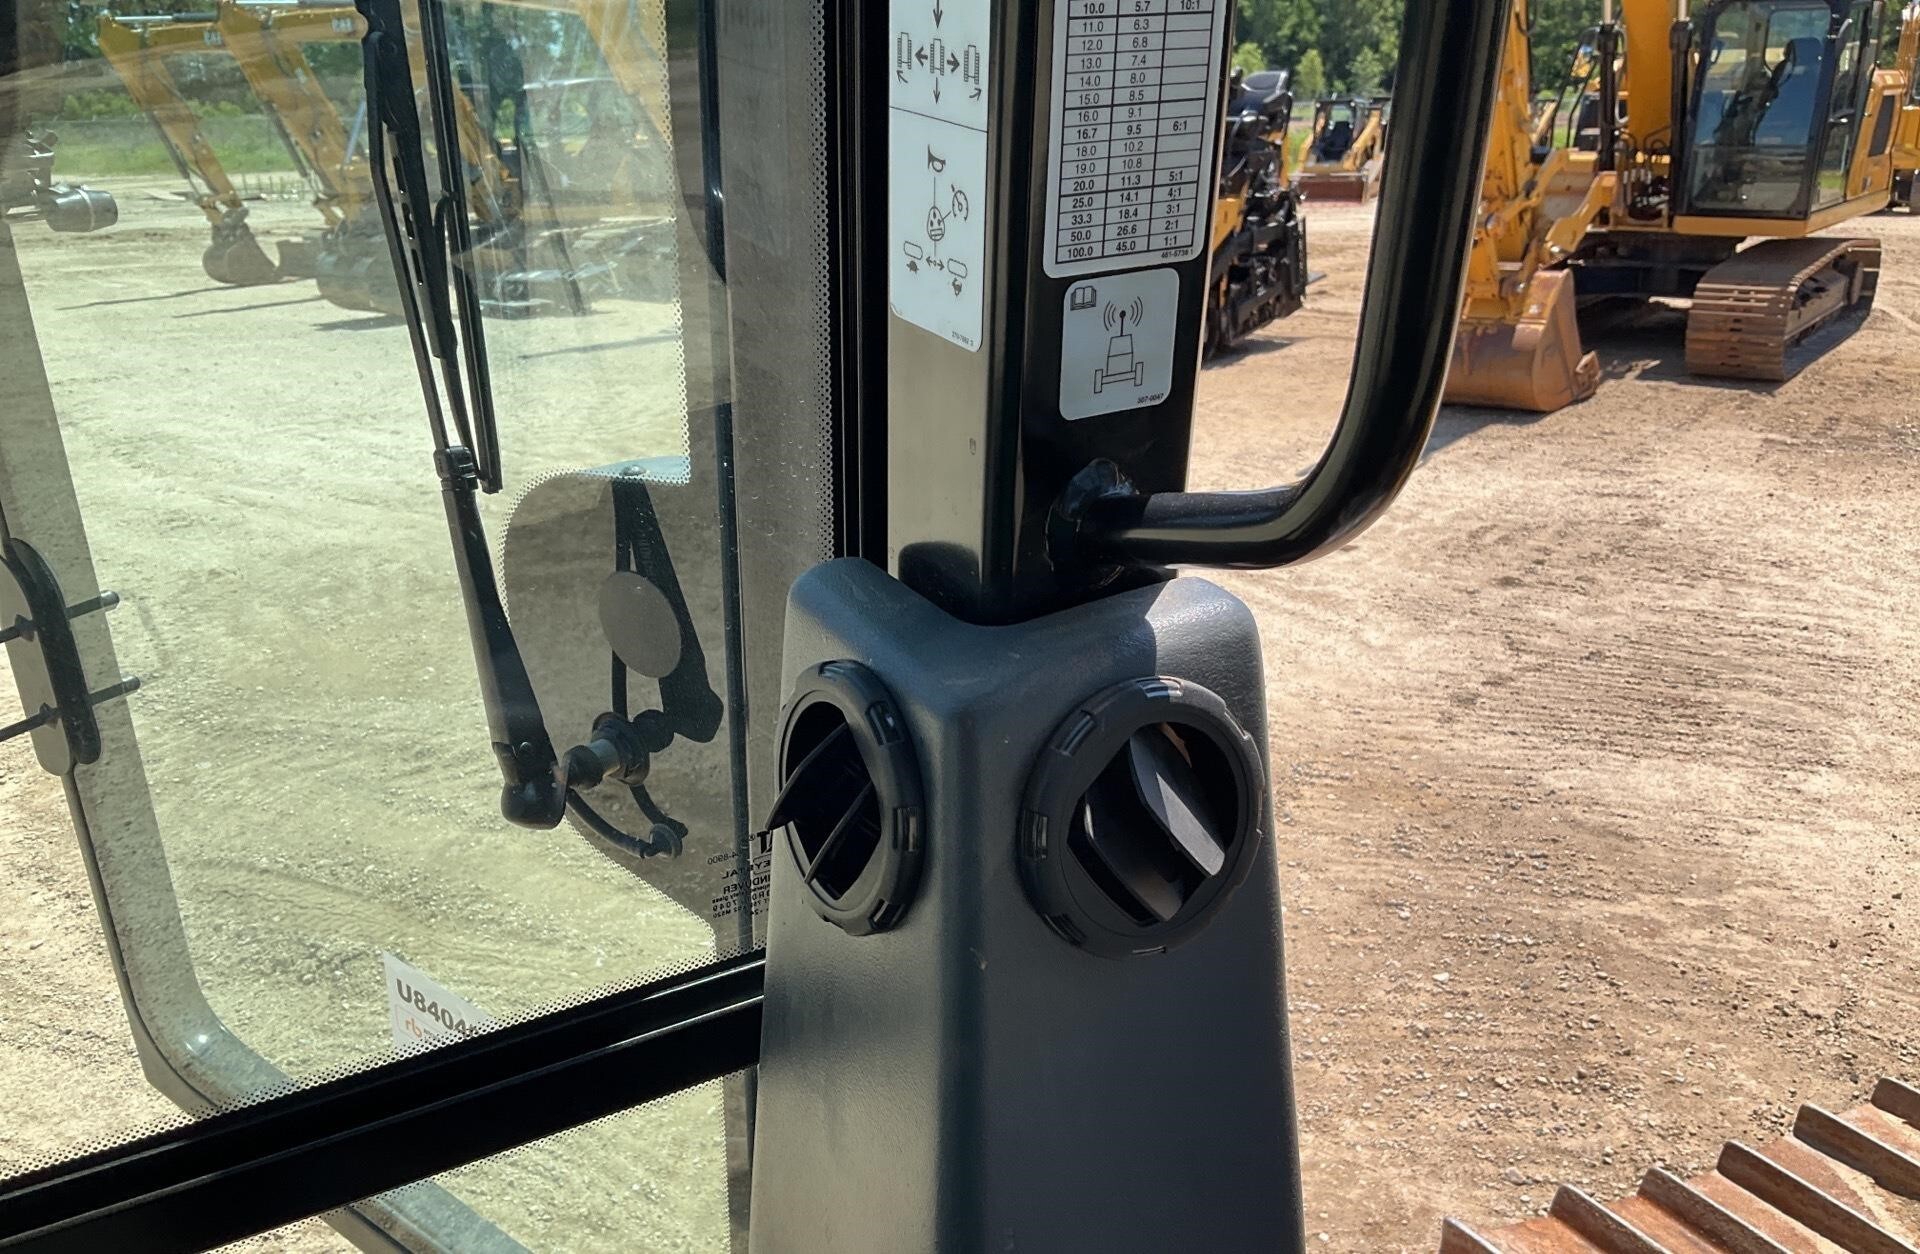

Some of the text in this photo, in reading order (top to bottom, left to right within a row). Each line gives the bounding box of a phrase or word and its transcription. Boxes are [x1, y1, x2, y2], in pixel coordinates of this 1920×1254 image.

[1083, 0, 1200, 14] 10.0 5.7 10:1
[1082, 19, 1149, 32] 11.0 6.3
[1082, 37, 1148, 51] 12.0 6.8
[1081, 55, 1146, 69] 13.0 7.4
[1080, 72, 1145, 87] 14.0 8.0
[1079, 90, 1144, 105] 15.0 8.5
[1078, 107, 1142, 122] 16.0 9.1
[1077, 120, 1187, 139] 16.7 9.5 6:1
[1076, 141, 1144, 157] 18.0 10.2
[1075, 158, 1142, 174] 19.0 10.8
[1073, 170, 1183, 191] 20.0 11.3 5:1
[1072, 187, 1182, 208] 25.0 14.1 4:1
[1071, 203, 1180, 225] 33.3 18.4 3:1
[1070, 219, 1179, 241] 50.0 26.6 2:1
[1067, 235, 1177, 258] 100.0 45.0 1:1
